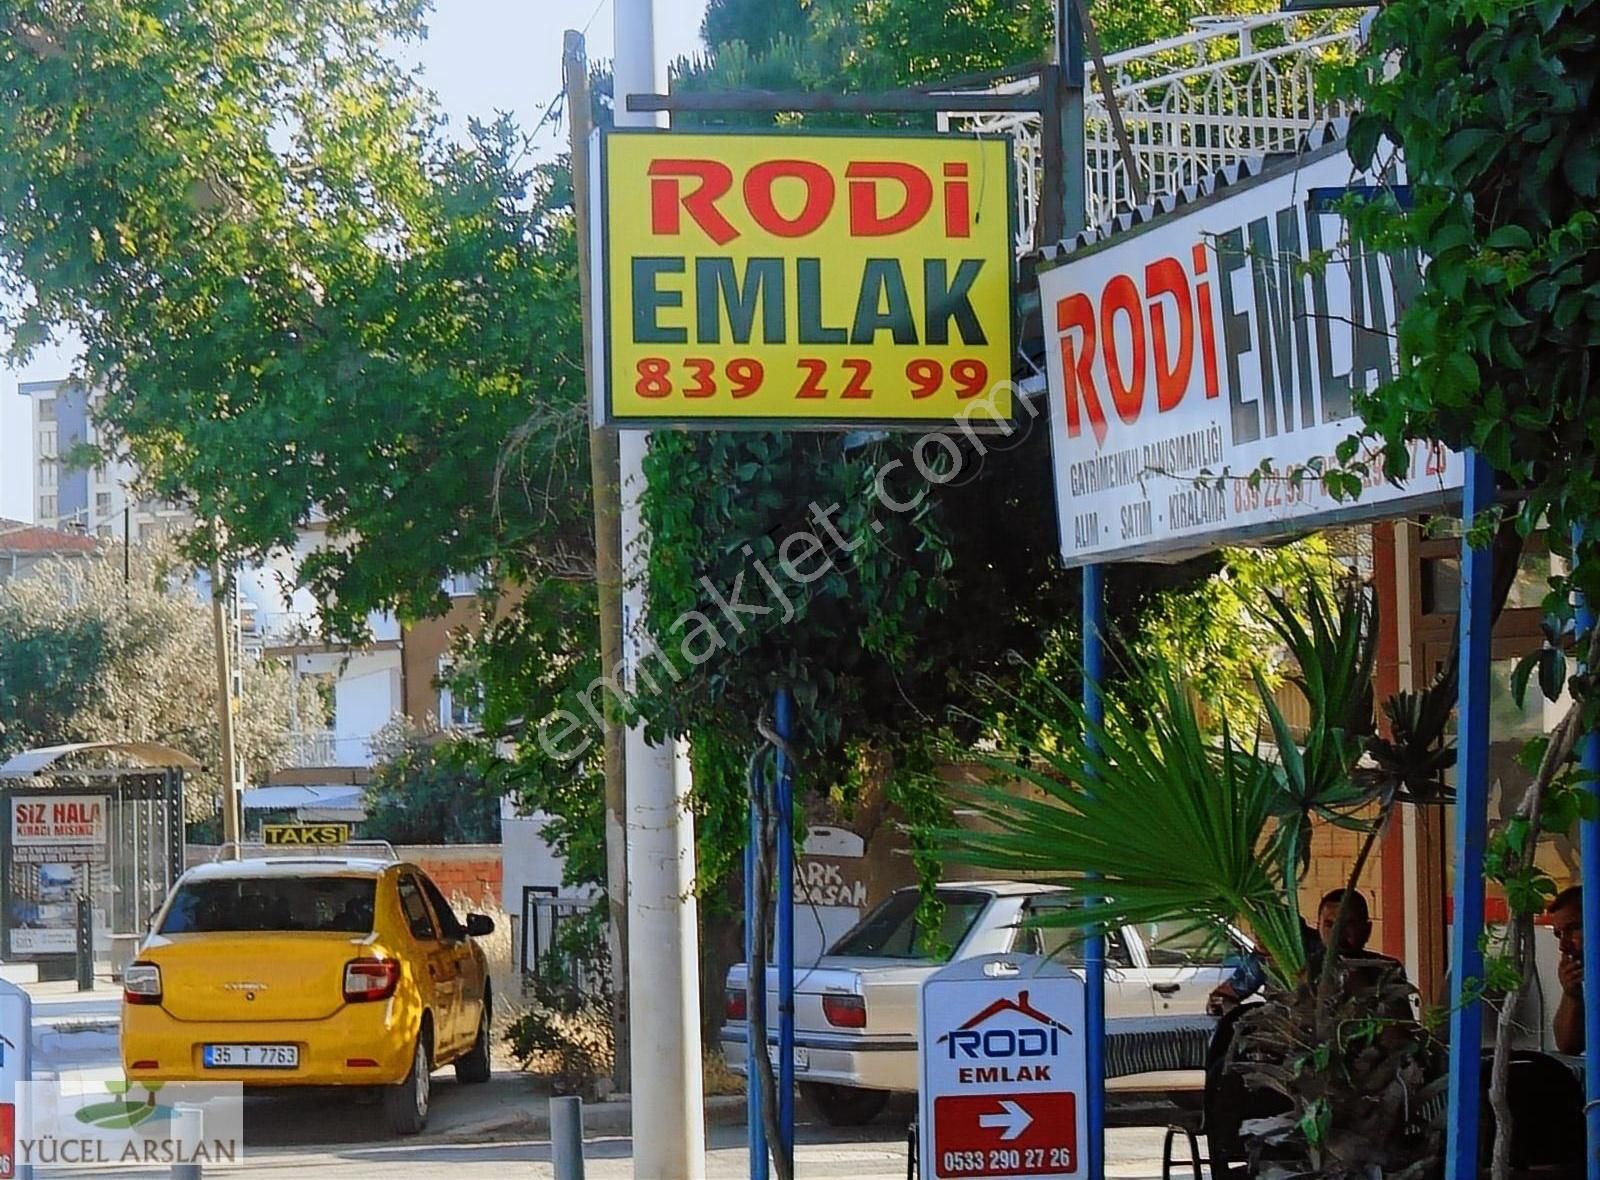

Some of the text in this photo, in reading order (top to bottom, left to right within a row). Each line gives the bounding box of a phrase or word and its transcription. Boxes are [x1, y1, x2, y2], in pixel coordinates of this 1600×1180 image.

[631, 255, 989, 347] EMLAK
[635, 357, 988, 400] 839 22 99
[1075, 486, 1227, 549] ALIM SATIM KİRALAMA
[214, 1047, 295, 1064] 35 T 7763
[949, 1028, 1058, 1060] RODI
[959, 1065, 1051, 1084] EMLAK
[944, 1147, 1071, 1172] 0533 290 27 26
